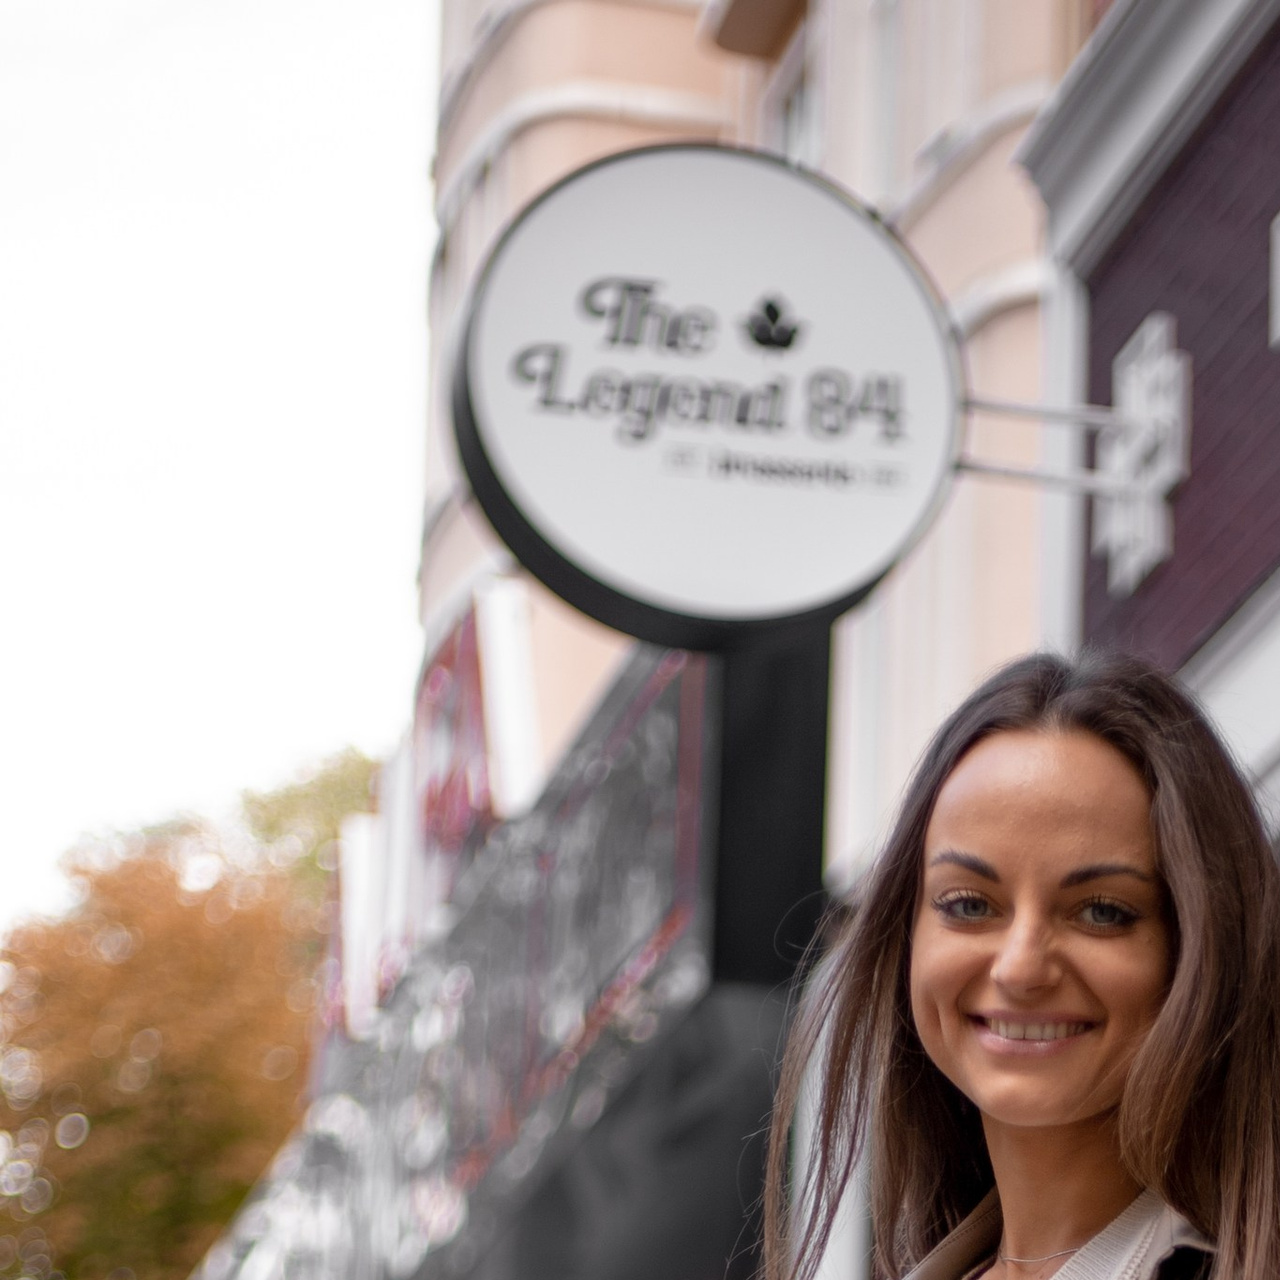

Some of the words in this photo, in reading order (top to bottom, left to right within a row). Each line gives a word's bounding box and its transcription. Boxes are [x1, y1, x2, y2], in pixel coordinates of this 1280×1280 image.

[578, 276, 718, 352] The
[510, 344, 790, 444] Legend
[805, 368, 910, 442] 84
